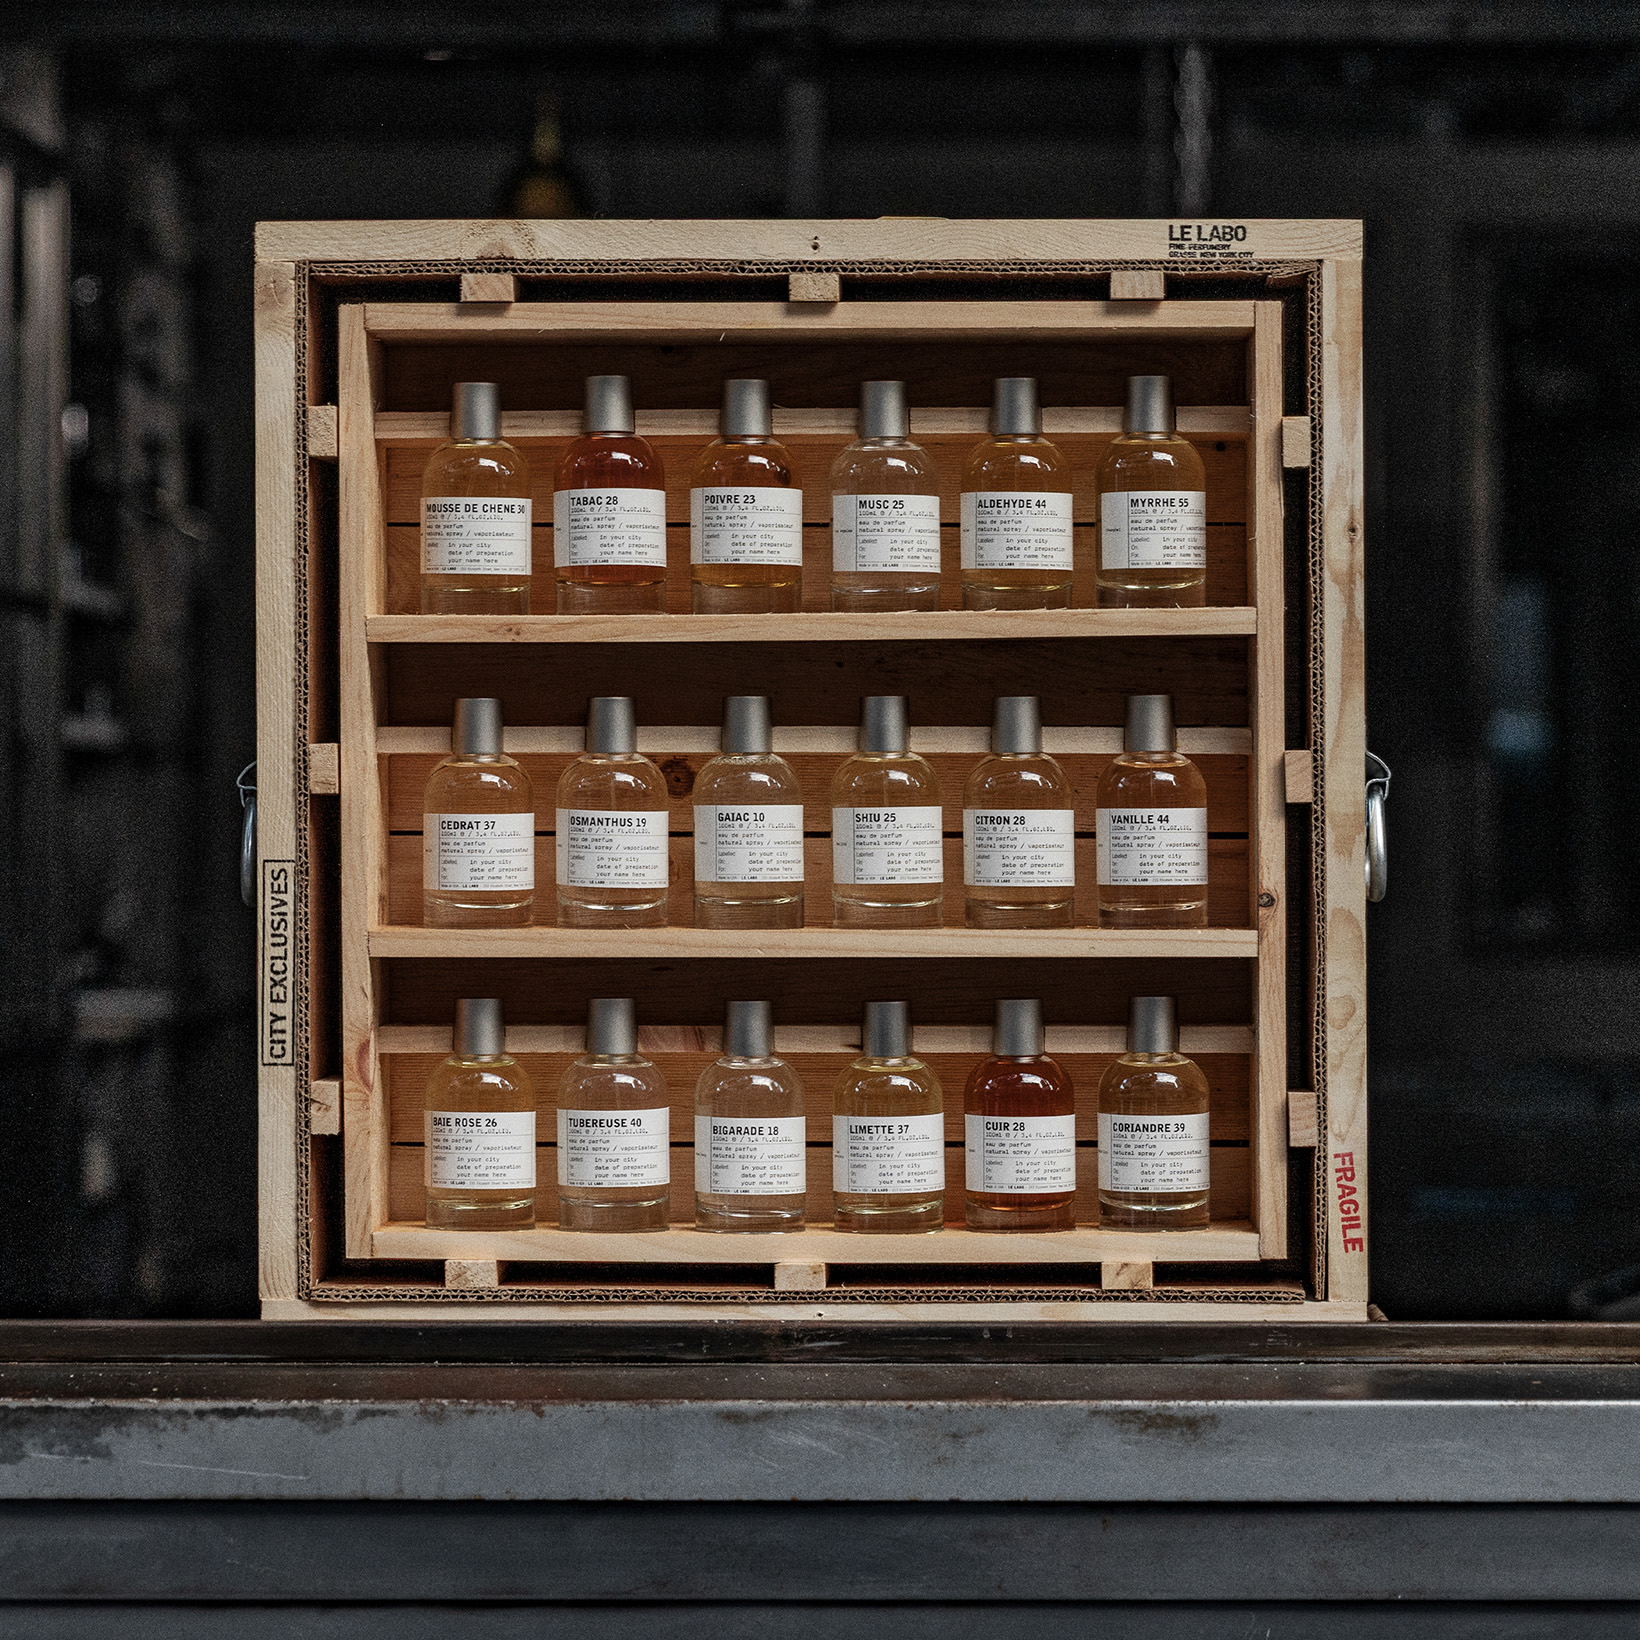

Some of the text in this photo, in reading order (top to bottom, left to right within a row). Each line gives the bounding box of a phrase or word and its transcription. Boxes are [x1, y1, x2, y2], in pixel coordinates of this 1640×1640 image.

[1168, 225, 1246, 241] LE LABO
[571, 496, 618, 506] TABAC 28
[705, 495, 756, 504] POIVRE 23
[977, 500, 1046, 508] ALDEHYDE 44
[1130, 498, 1189, 507] MYRRHE 55
[427, 504, 461, 513] MOUSSE
[464, 504, 478, 512] DE
[482, 504, 515, 513] CHENE
[859, 500, 904, 509] MUSC 25
[570, 816, 647, 827] OSMANTHUS 19
[718, 813, 764, 821] GAIAC 10
[855, 813, 896, 822] SHIU 25
[976, 816, 1026, 825] CITRON 28
[1111, 815, 1169, 824] VANILLE 44
[441, 821, 496, 830] CEDRAT 37
[270, 868, 288, 1059] CITY EXCLUSIVES
[433, 1117, 497, 1127] BAIE ROSE 26
[569, 1118, 642, 1127] TUBEREUSE 40
[986, 1122, 1025, 1131] CUIR 28
[713, 1126, 779, 1135] BIGARADE 18
[850, 1125, 909, 1134] LIMETTE 37
[1113, 1123, 1185, 1132] CORIANDRE 39
[1333, 1152, 1364, 1253] FRAGILE
